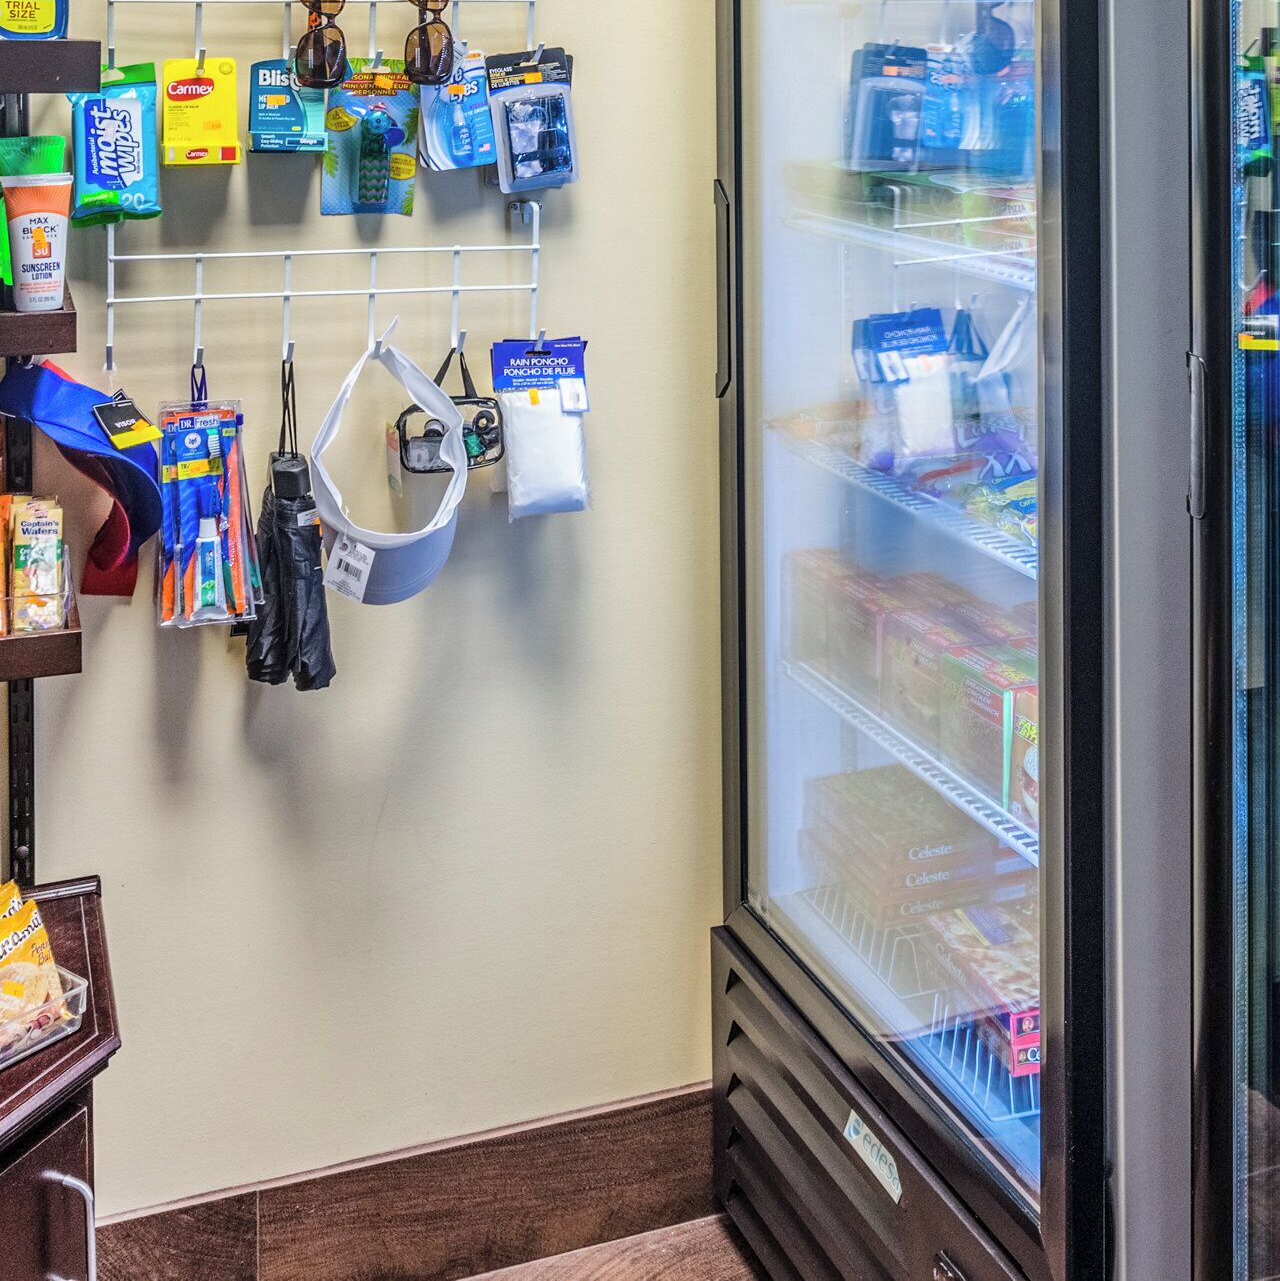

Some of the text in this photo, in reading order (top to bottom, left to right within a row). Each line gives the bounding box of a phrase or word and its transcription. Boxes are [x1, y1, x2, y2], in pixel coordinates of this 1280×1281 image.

[5, 0, 41, 11] TRIAL
[9, 9, 36, 20] SIZE
[167, 82, 214, 96] Carmex
[353, 88, 397, 96] PERSONNEL
[90, 105, 119, 177] moist
[113, 109, 140, 176] wipes
[86, 136, 99, 175] Antibacterial
[186, 149, 209, 159] Carmex
[121, 192, 146, 209] 20
[29, 217, 49, 225] MAX
[21, 261, 61, 274] SUNSCREEN
[31, 272, 53, 281] LOTION
[510, 358, 568, 366] RAIN PONCHO
[504, 367, 576, 377] PONCHO DE PLUIE
[179, 418, 219, 431] DR. Fresh
[20, 520, 60, 528] Captain's
[21, 527, 59, 536] Wafers
[966, 686, 992, 706] CHICKEN
[908, 844, 953, 861] Celeste
[906, 869, 951, 887] Celeste
[900, 899, 944, 916] Celeste
[862, 1132, 902, 1193] edesa
